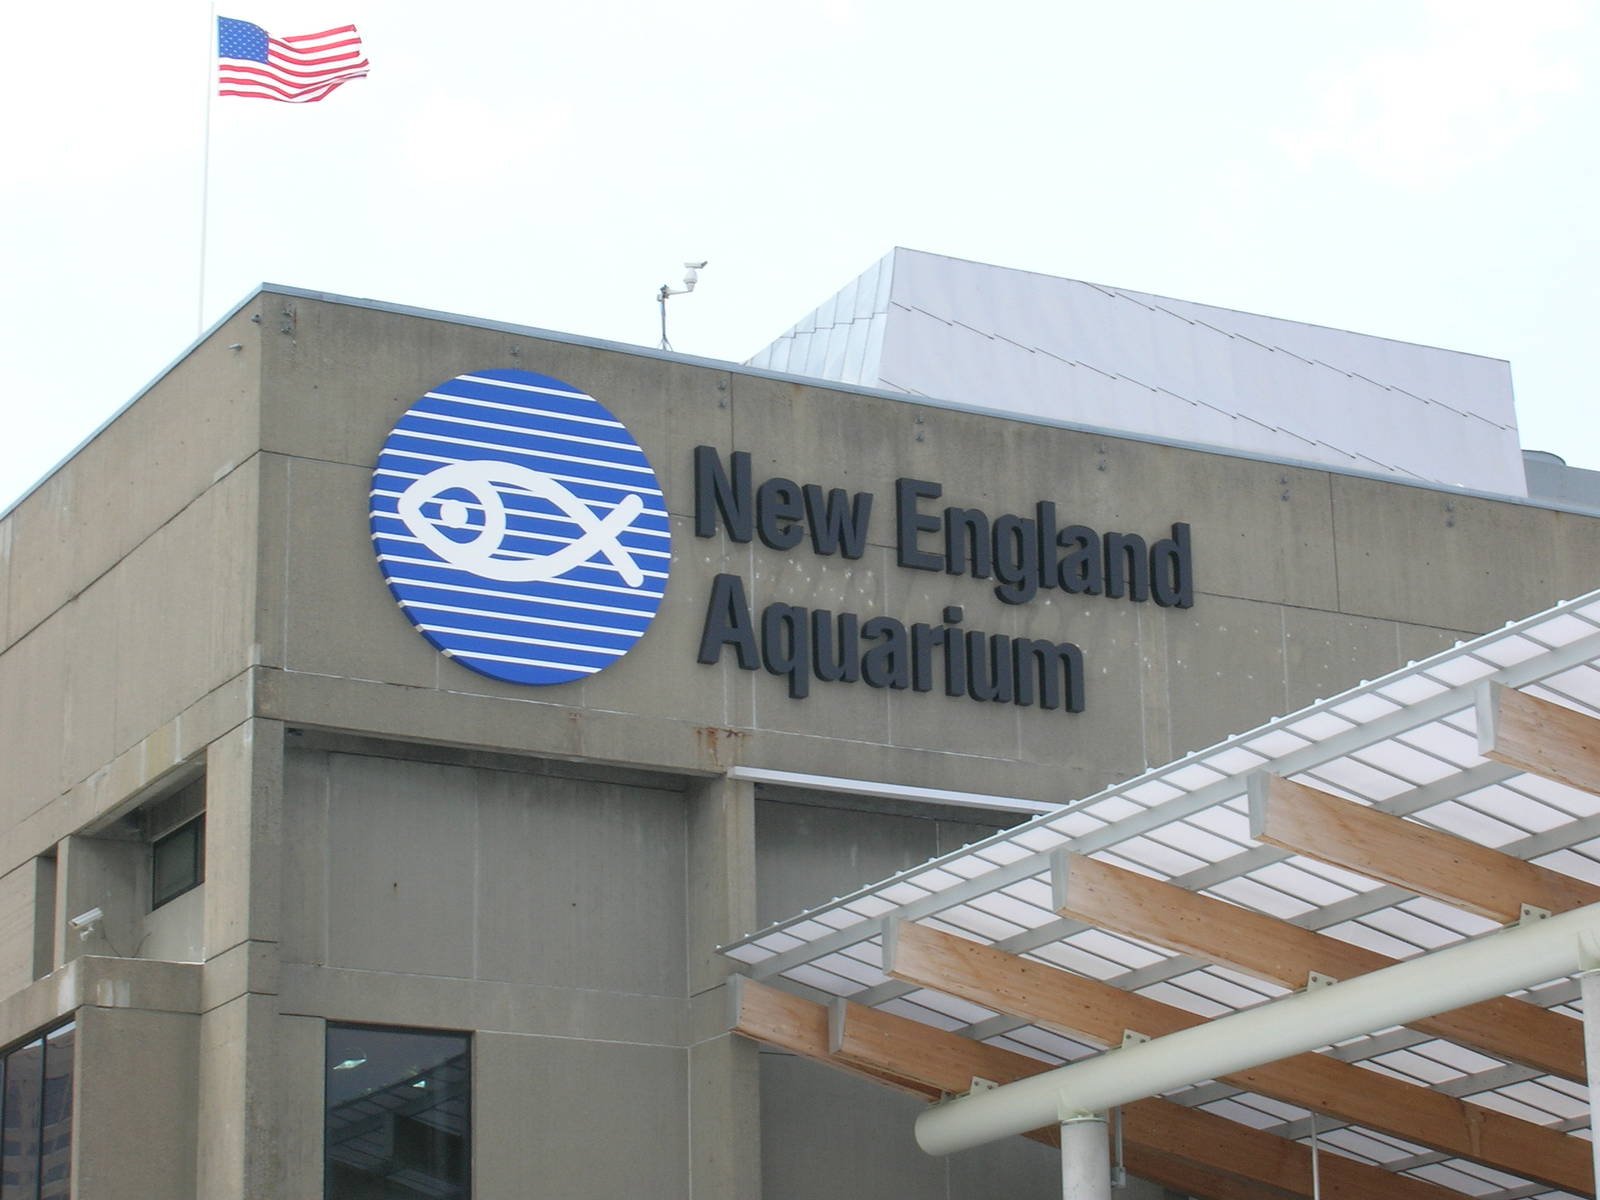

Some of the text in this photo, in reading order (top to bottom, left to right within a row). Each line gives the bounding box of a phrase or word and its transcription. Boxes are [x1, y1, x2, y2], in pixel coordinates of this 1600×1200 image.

[694, 445, 1193, 610] New England
[697, 573, 1085, 714] Aquarium
